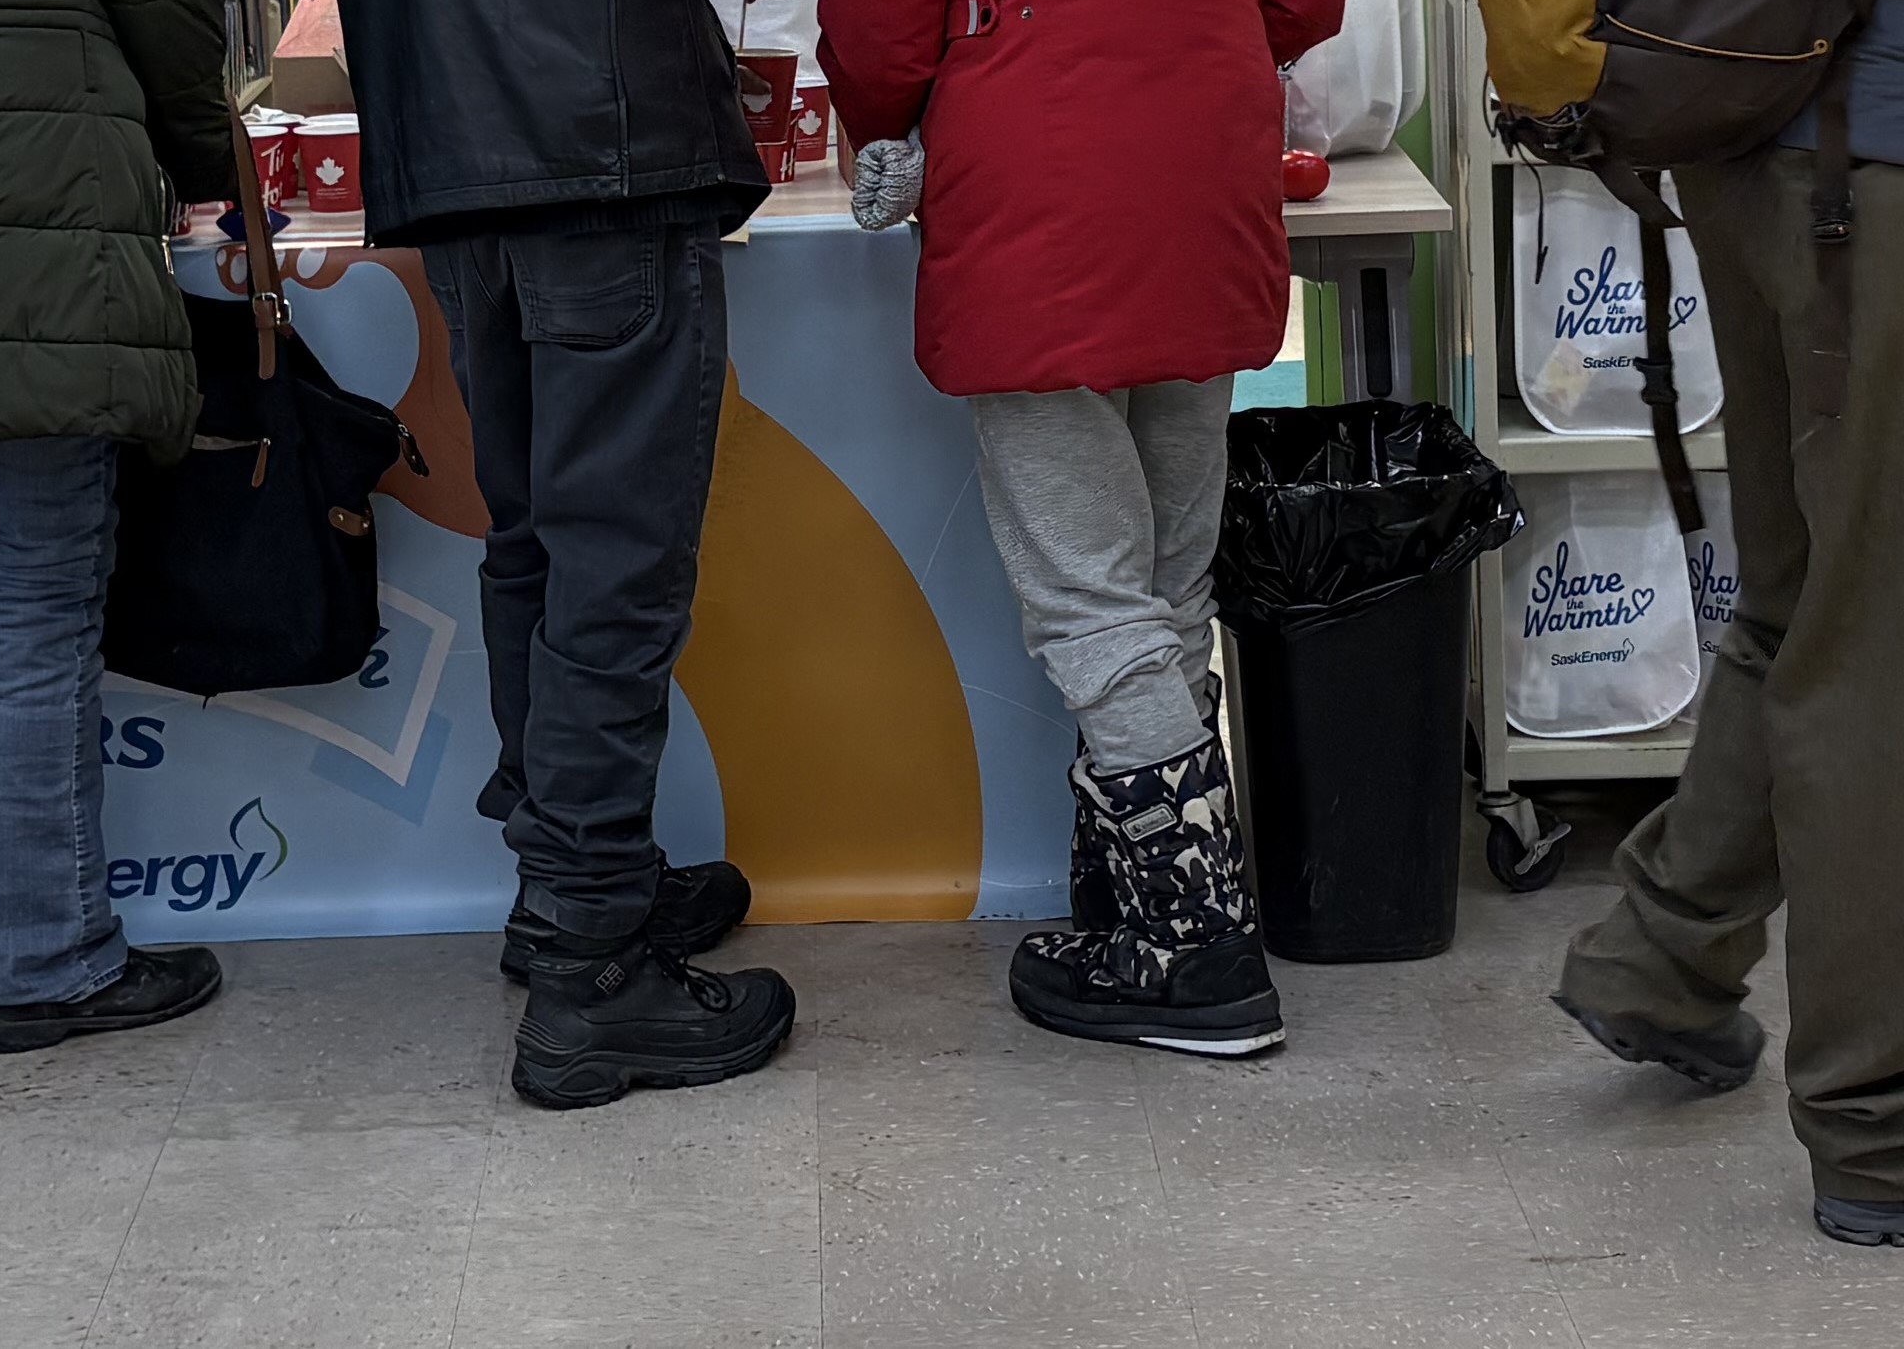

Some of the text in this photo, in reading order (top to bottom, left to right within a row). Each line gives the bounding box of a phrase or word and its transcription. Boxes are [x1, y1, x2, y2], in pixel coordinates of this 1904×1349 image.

[1567, 246, 1646, 306] Shar
[1555, 304, 1648, 339] Warm
[1607, 302, 1626, 315] the
[1532, 540, 1625, 604] Share
[1523, 602, 1636, 638] Warmth
[1566, 598, 1584, 610] the
[1551, 648, 1631, 667] SaskEnergy
